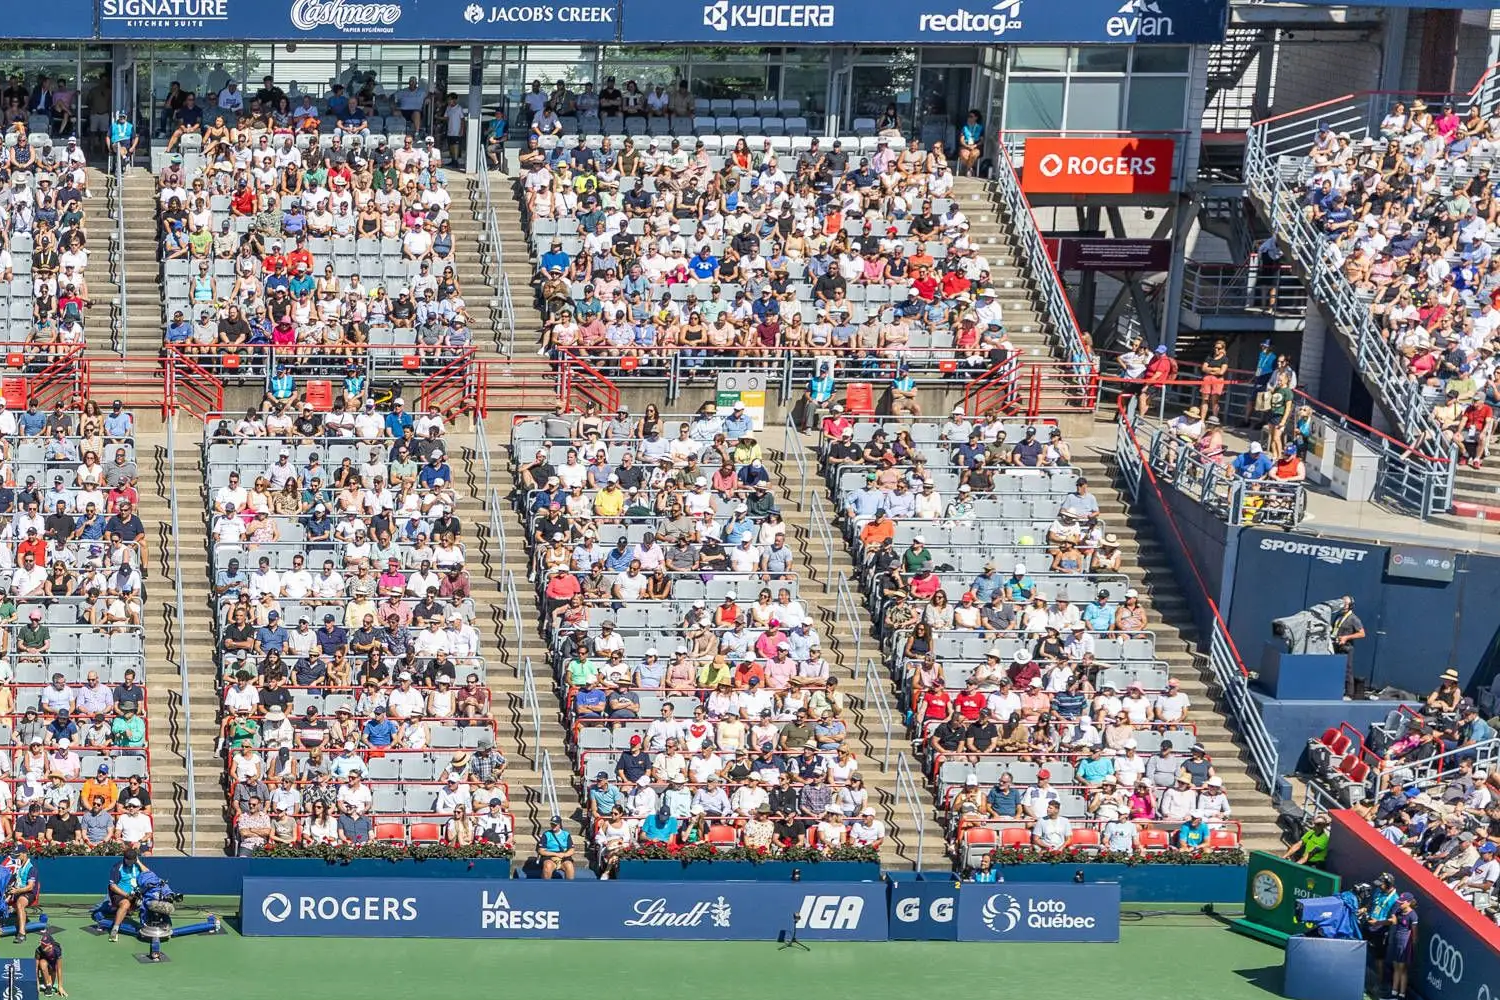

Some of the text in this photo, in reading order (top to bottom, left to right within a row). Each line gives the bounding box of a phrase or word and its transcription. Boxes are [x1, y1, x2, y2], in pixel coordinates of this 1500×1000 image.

[103, 0, 228, 16] SIGNATURE
[291, 0, 402, 31] Cashmere
[487, 6, 613, 23] JACOB'S CREEK
[731, 5, 834, 28] KYOCERA
[1107, 14, 1173, 37] evian
[1066, 156, 1157, 175] ROGERS
[1259, 538, 1368, 562] SPORTSNET
[299, 896, 418, 922] ROGERS
[481, 890, 510, 908] LA
[1028, 898, 1066, 912] Loto
[481, 909, 560, 930] PRESSE
[624, 897, 712, 928] Lindt
[796, 895, 864, 930] IGA
[1027, 912, 1095, 929] Québec
